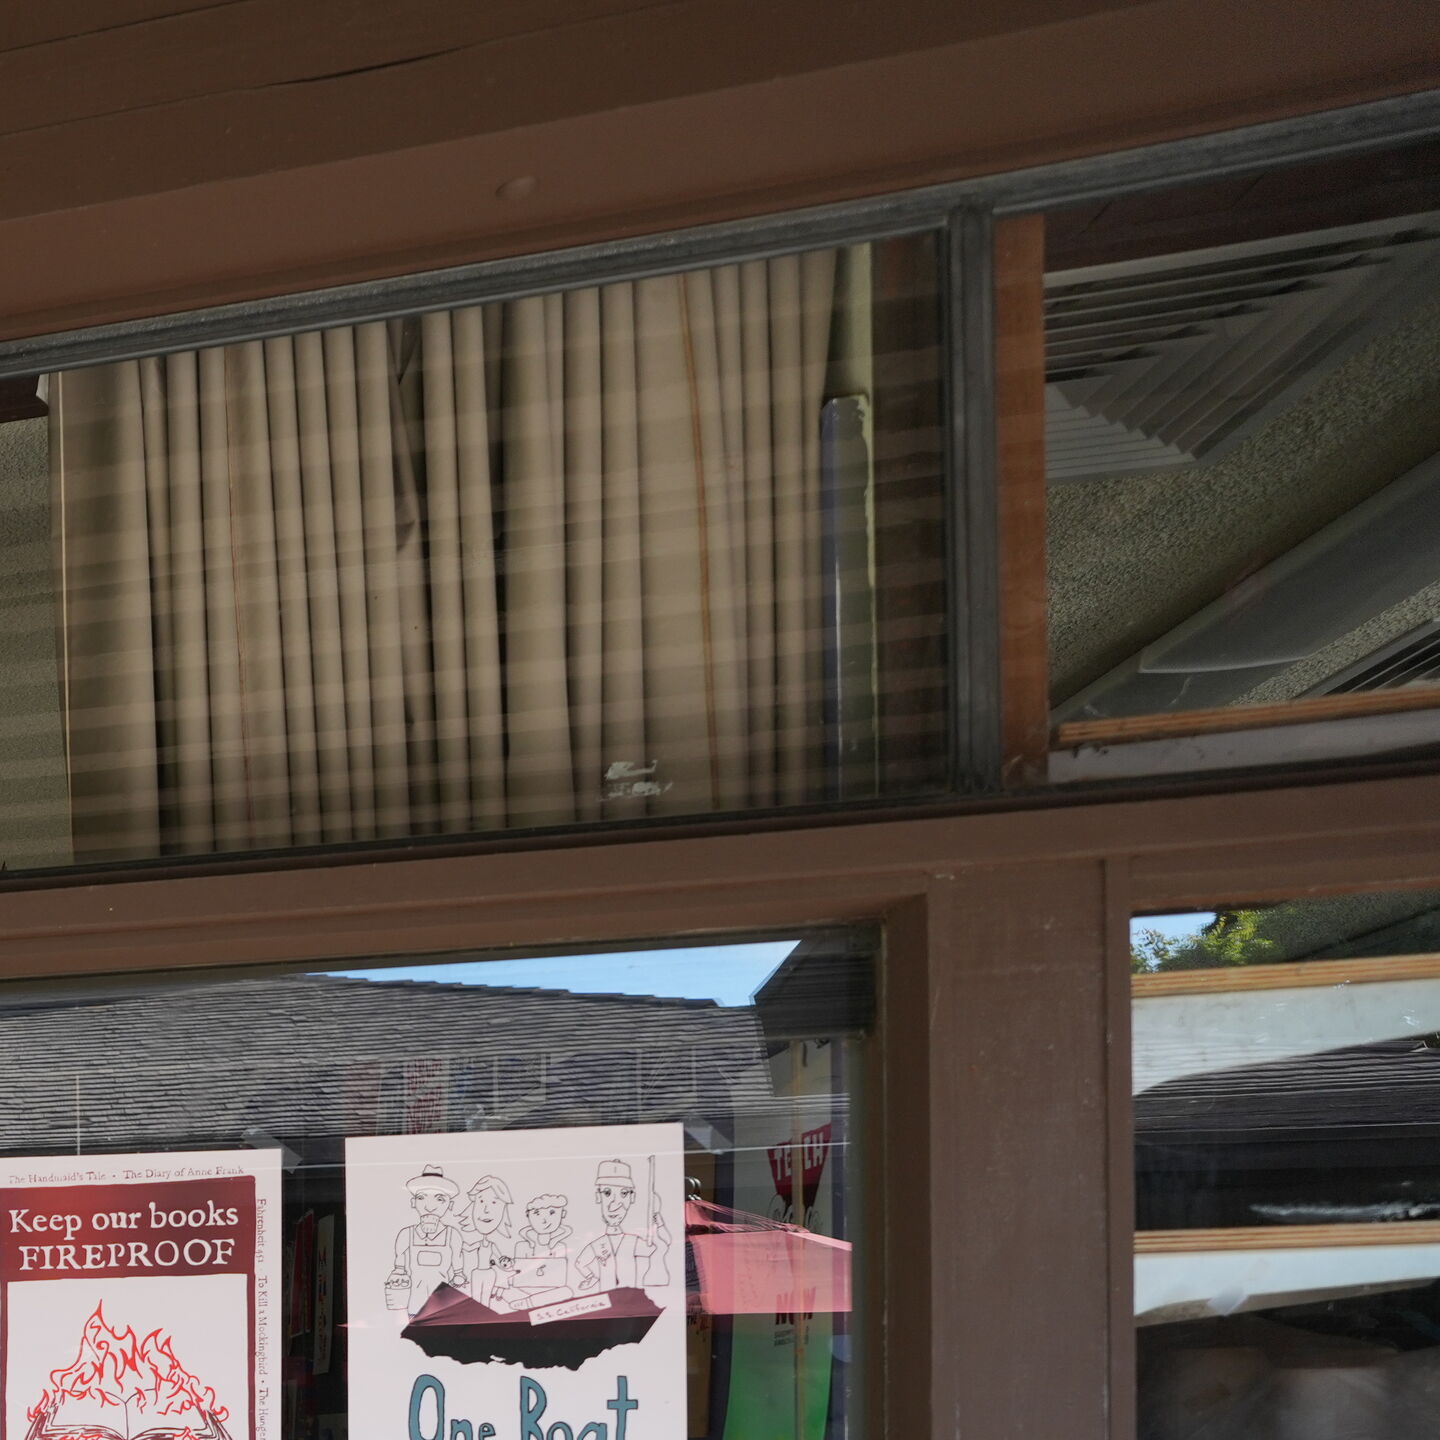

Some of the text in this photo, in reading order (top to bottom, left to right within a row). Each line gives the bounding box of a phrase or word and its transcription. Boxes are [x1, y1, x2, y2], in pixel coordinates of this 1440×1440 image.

[774, 1131, 824, 1181] TECH
[123, 1170, 142, 1180] The
[145, 1169, 170, 1180] Diary
[174, 1168, 186, 1178] of
[187, 1167, 213, 1177] Anne
[215, 1166, 244, 1176] Frank
[9, 1200, 239, 1241] Keep our books
[18, 1238, 237, 1273] FIREPROOF
[258, 1275, 267, 1288] To
[259, 1290, 268, 1307] Kill
[254, 1316, 268, 1375] Mockingbird
[258, 1387, 269, 1407] The
